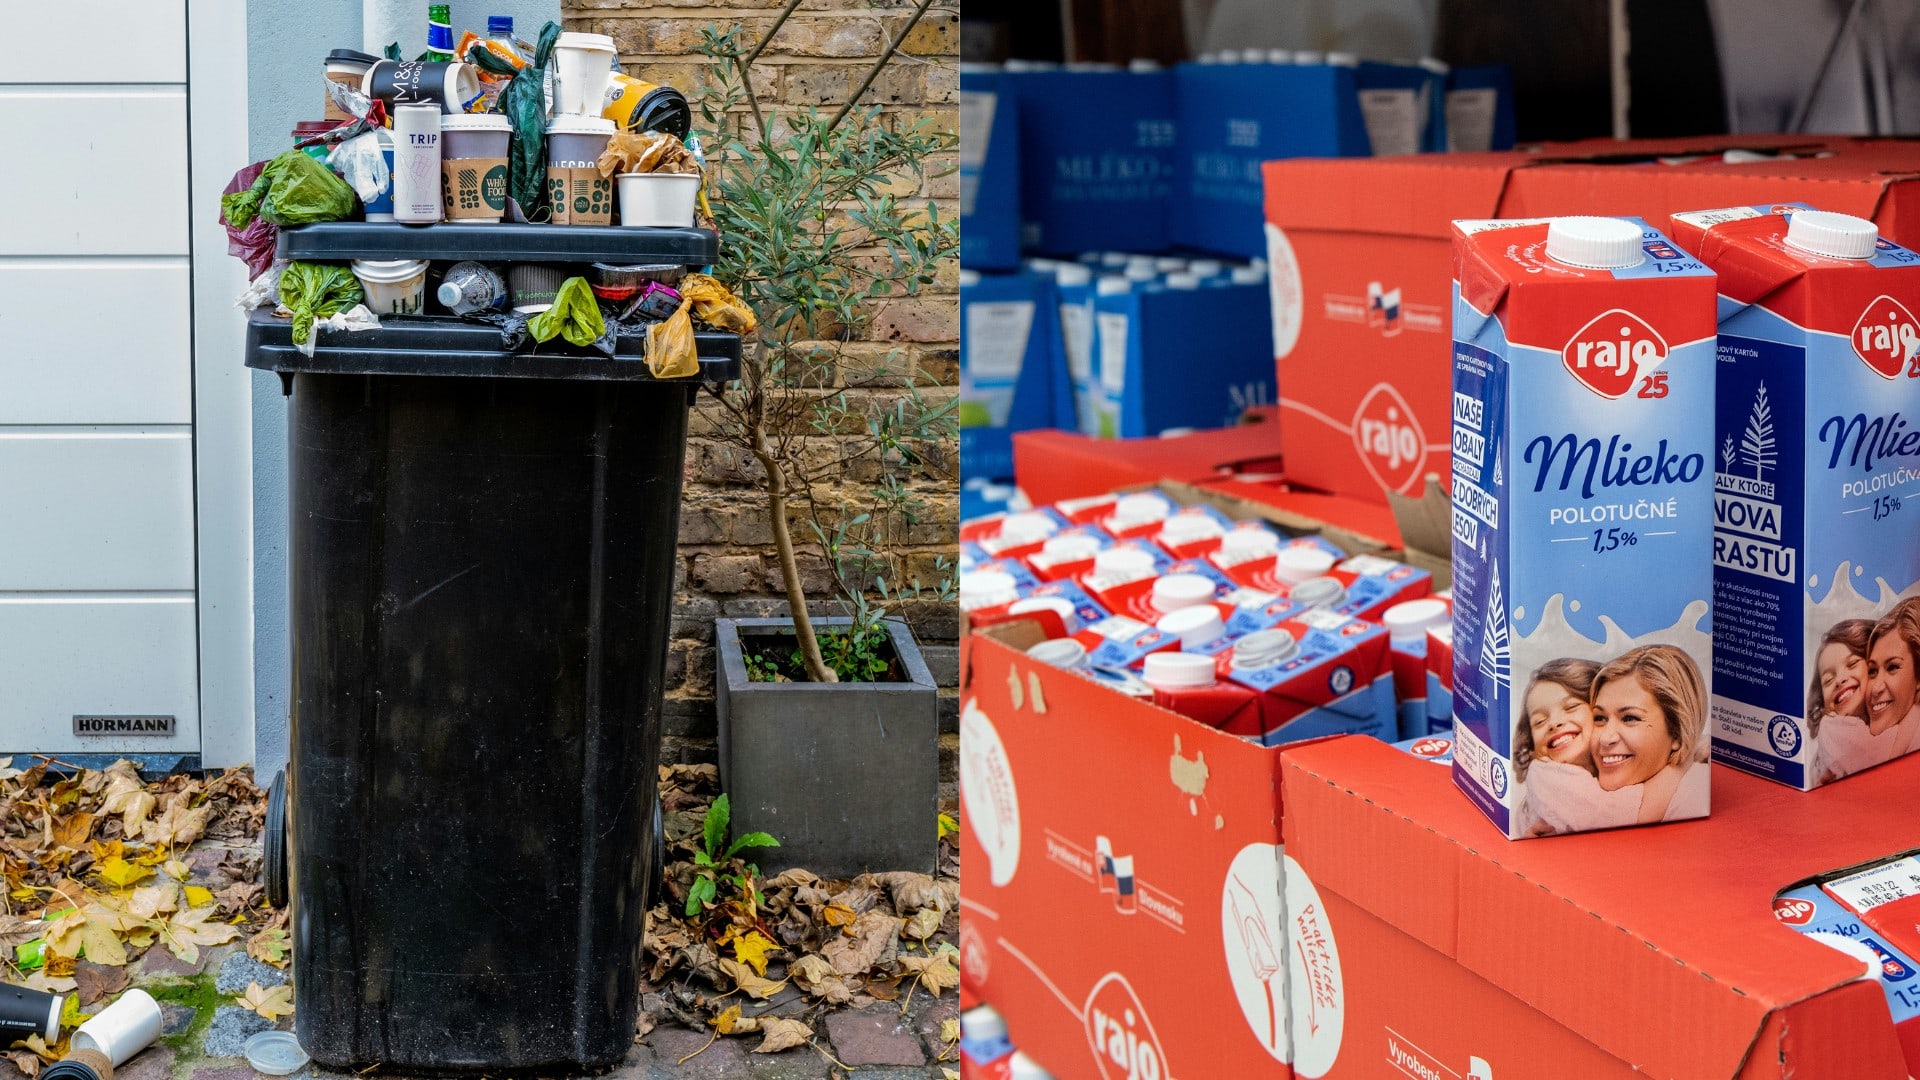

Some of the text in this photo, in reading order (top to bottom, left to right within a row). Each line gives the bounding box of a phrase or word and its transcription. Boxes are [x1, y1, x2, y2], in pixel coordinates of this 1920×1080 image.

[392, 61, 417, 101] M&S
[409, 134, 437, 144] TRIP
[1653, 262, 1703, 274] 1,5%
[1861, 311, 1916, 359] rajo
[1577, 326, 1657, 377] rajo
[1637, 375, 1669, 399] 25
[1455, 396, 1482, 427] NAŠE
[1361, 406, 1418, 469] rajo
[1454, 430, 1484, 462] OBALY
[1819, 412, 1920, 472] Mlie
[1524, 433, 1704, 499] Mlieko
[1738, 480, 1773, 497] KTORÉ
[1843, 466, 1920, 499] POLOTUČN
[1459, 481, 1497, 525] DOBRÝCH
[1550, 497, 1678, 525] POLOTUČNÉ
[1873, 494, 1902, 522] 1,5%
[1593, 527, 1638, 554] 1,5%
[1714, 536, 1791, 577] RASTÚ
[79, 718, 168, 731] HÖRMANN
[1413, 739, 1448, 754] rajo
[1093, 1007, 1160, 1080] rajo
